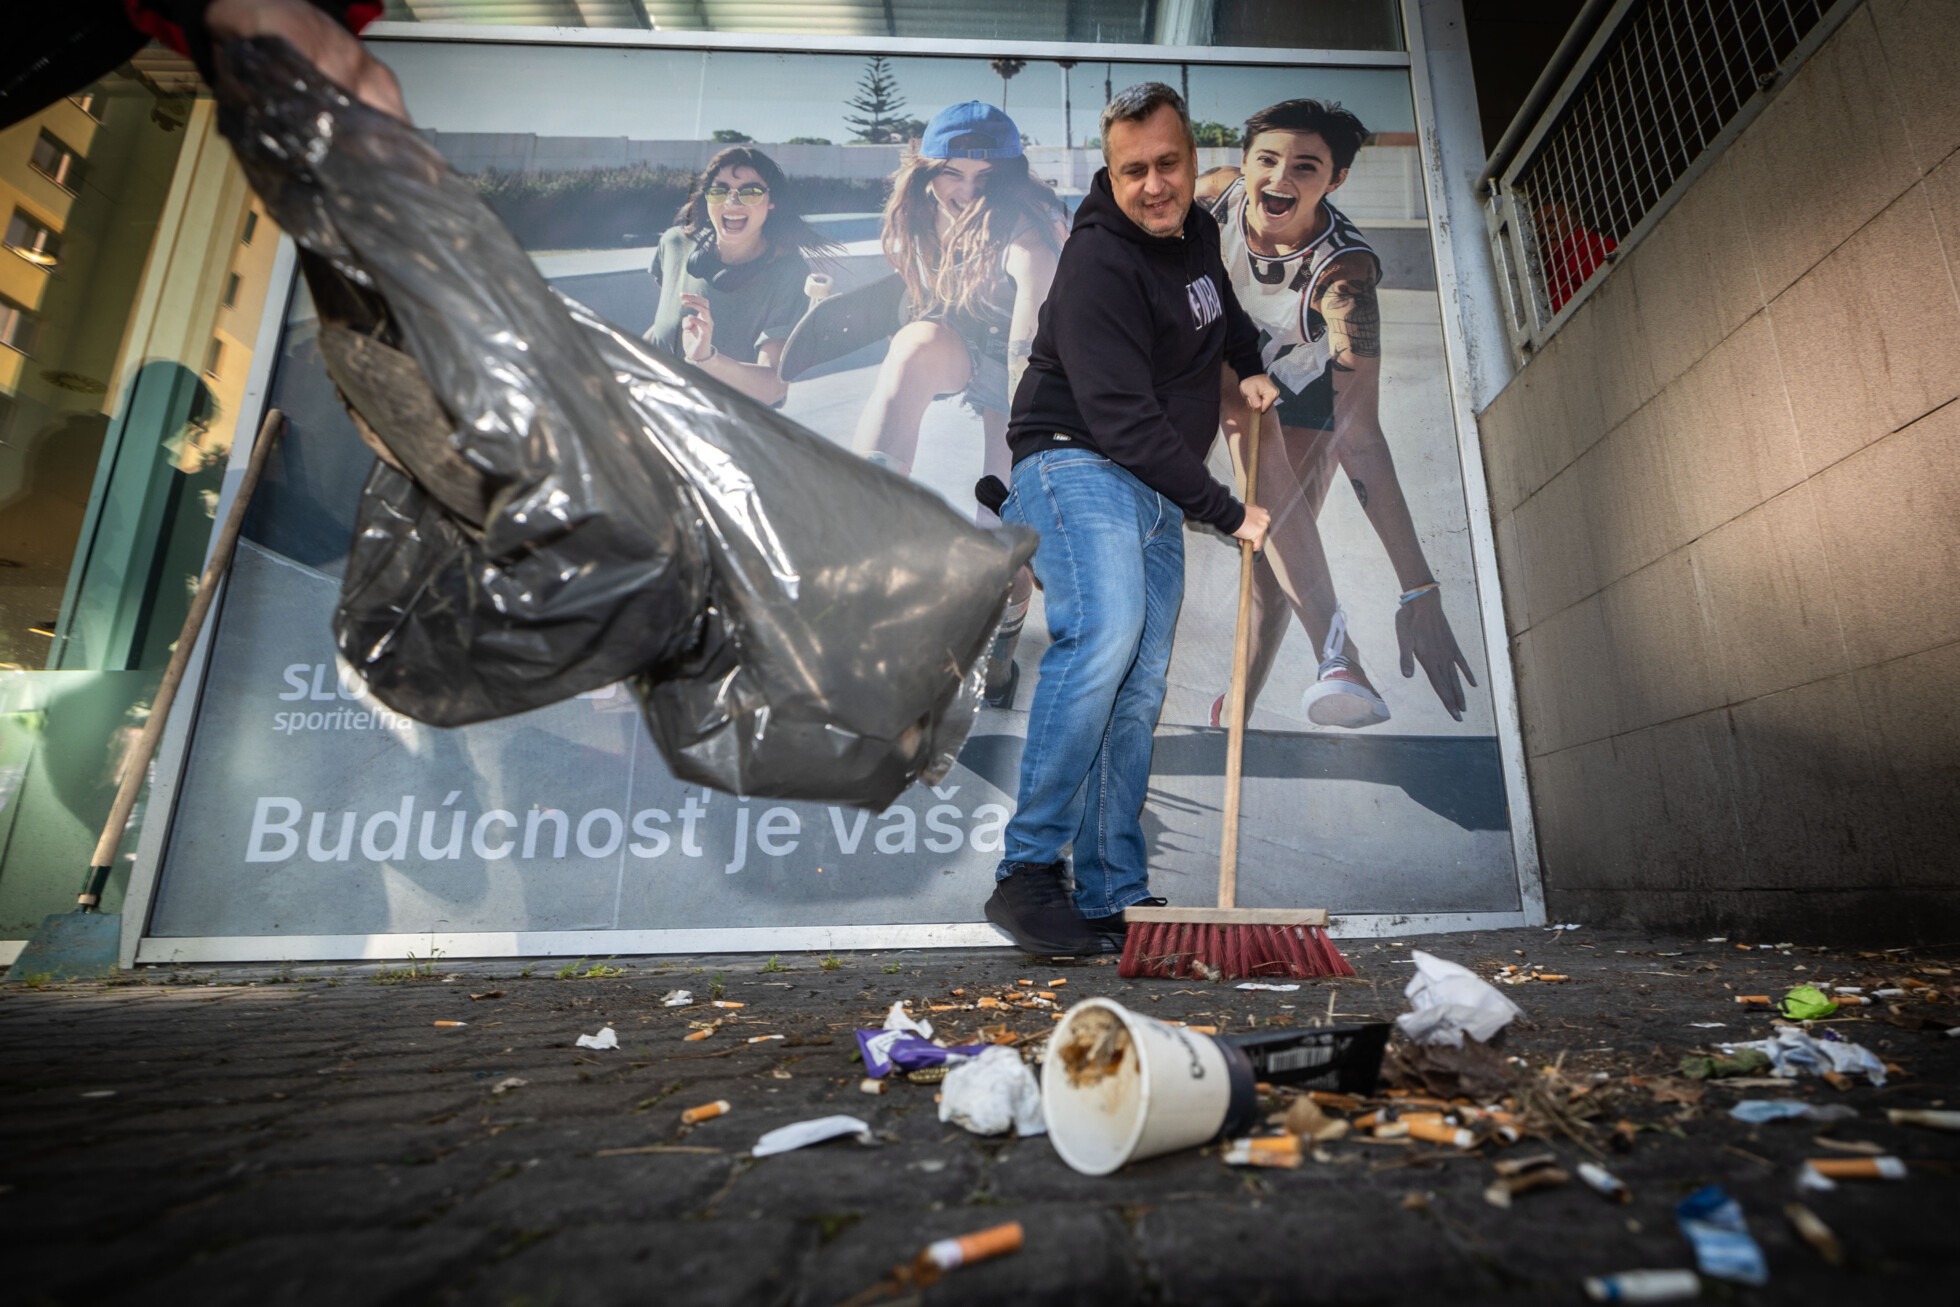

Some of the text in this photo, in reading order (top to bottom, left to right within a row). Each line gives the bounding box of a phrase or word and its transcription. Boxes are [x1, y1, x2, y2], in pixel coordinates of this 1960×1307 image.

[278, 663, 369, 701] SLO
[244, 785, 1006, 875] Budúcnosť je vaša
